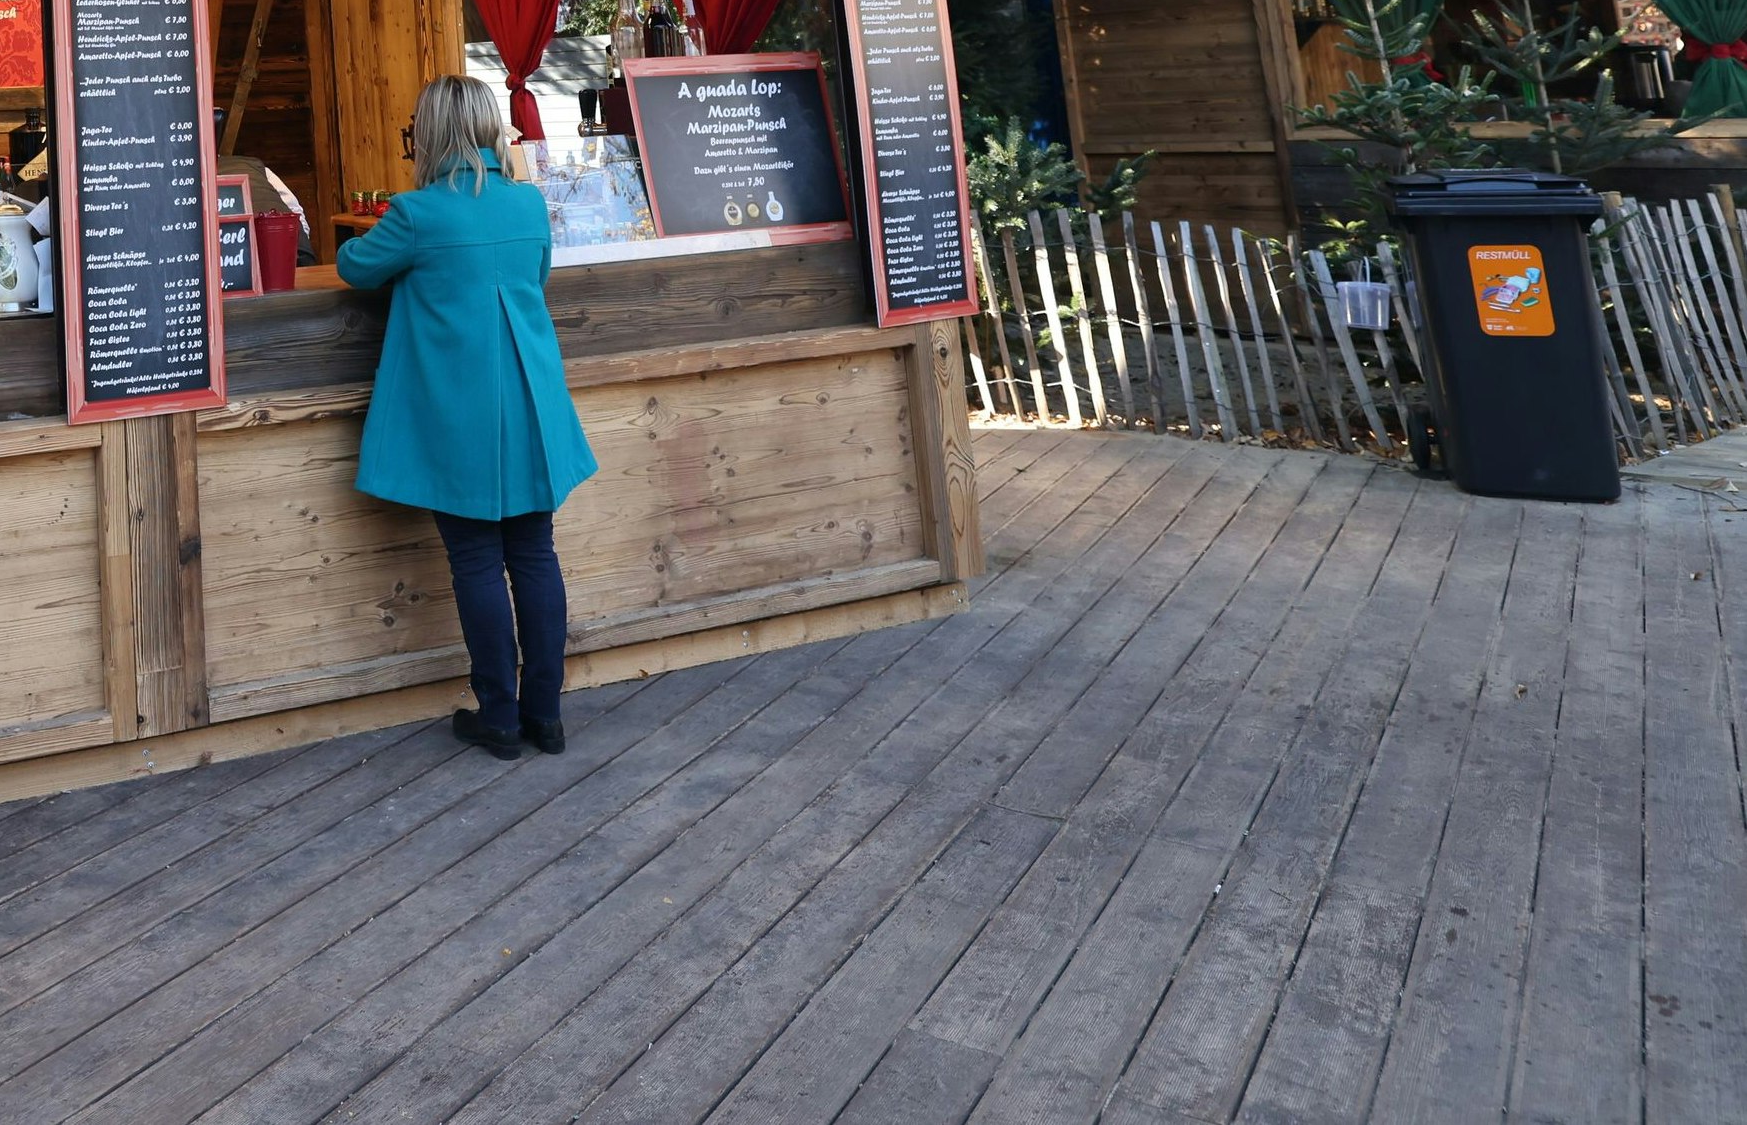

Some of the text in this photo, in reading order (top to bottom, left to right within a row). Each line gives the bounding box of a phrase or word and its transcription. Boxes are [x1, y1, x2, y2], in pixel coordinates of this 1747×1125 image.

[78, 50, 189, 61] Amaretto-Apfel-Punsch € 6,00
[678, 79, 781, 102] A guada Lop:
[707, 103, 761, 118] Mozarts
[81, 126, 112, 136] Jaga-Tee
[686, 117, 786, 136] Marzipan-Punsch
[82, 134, 192, 147] Kinder-Apfel-Punsch € 3,90
[705, 148, 737, 157] Amaretto
[744, 146, 778, 155] Marzipan
[694, 166, 712, 175] Dazu
[734, 164, 751, 172] einen
[753, 160, 794, 171] Mozartlikör
[85, 227, 124, 238] Stiegl Bier
[1476, 249, 1531, 260] RESTMÜLL
[88, 297, 127, 308] Coca Cola
[88, 308, 147, 320] Coca Cola Light
[90, 361, 132, 371] Almdudler
